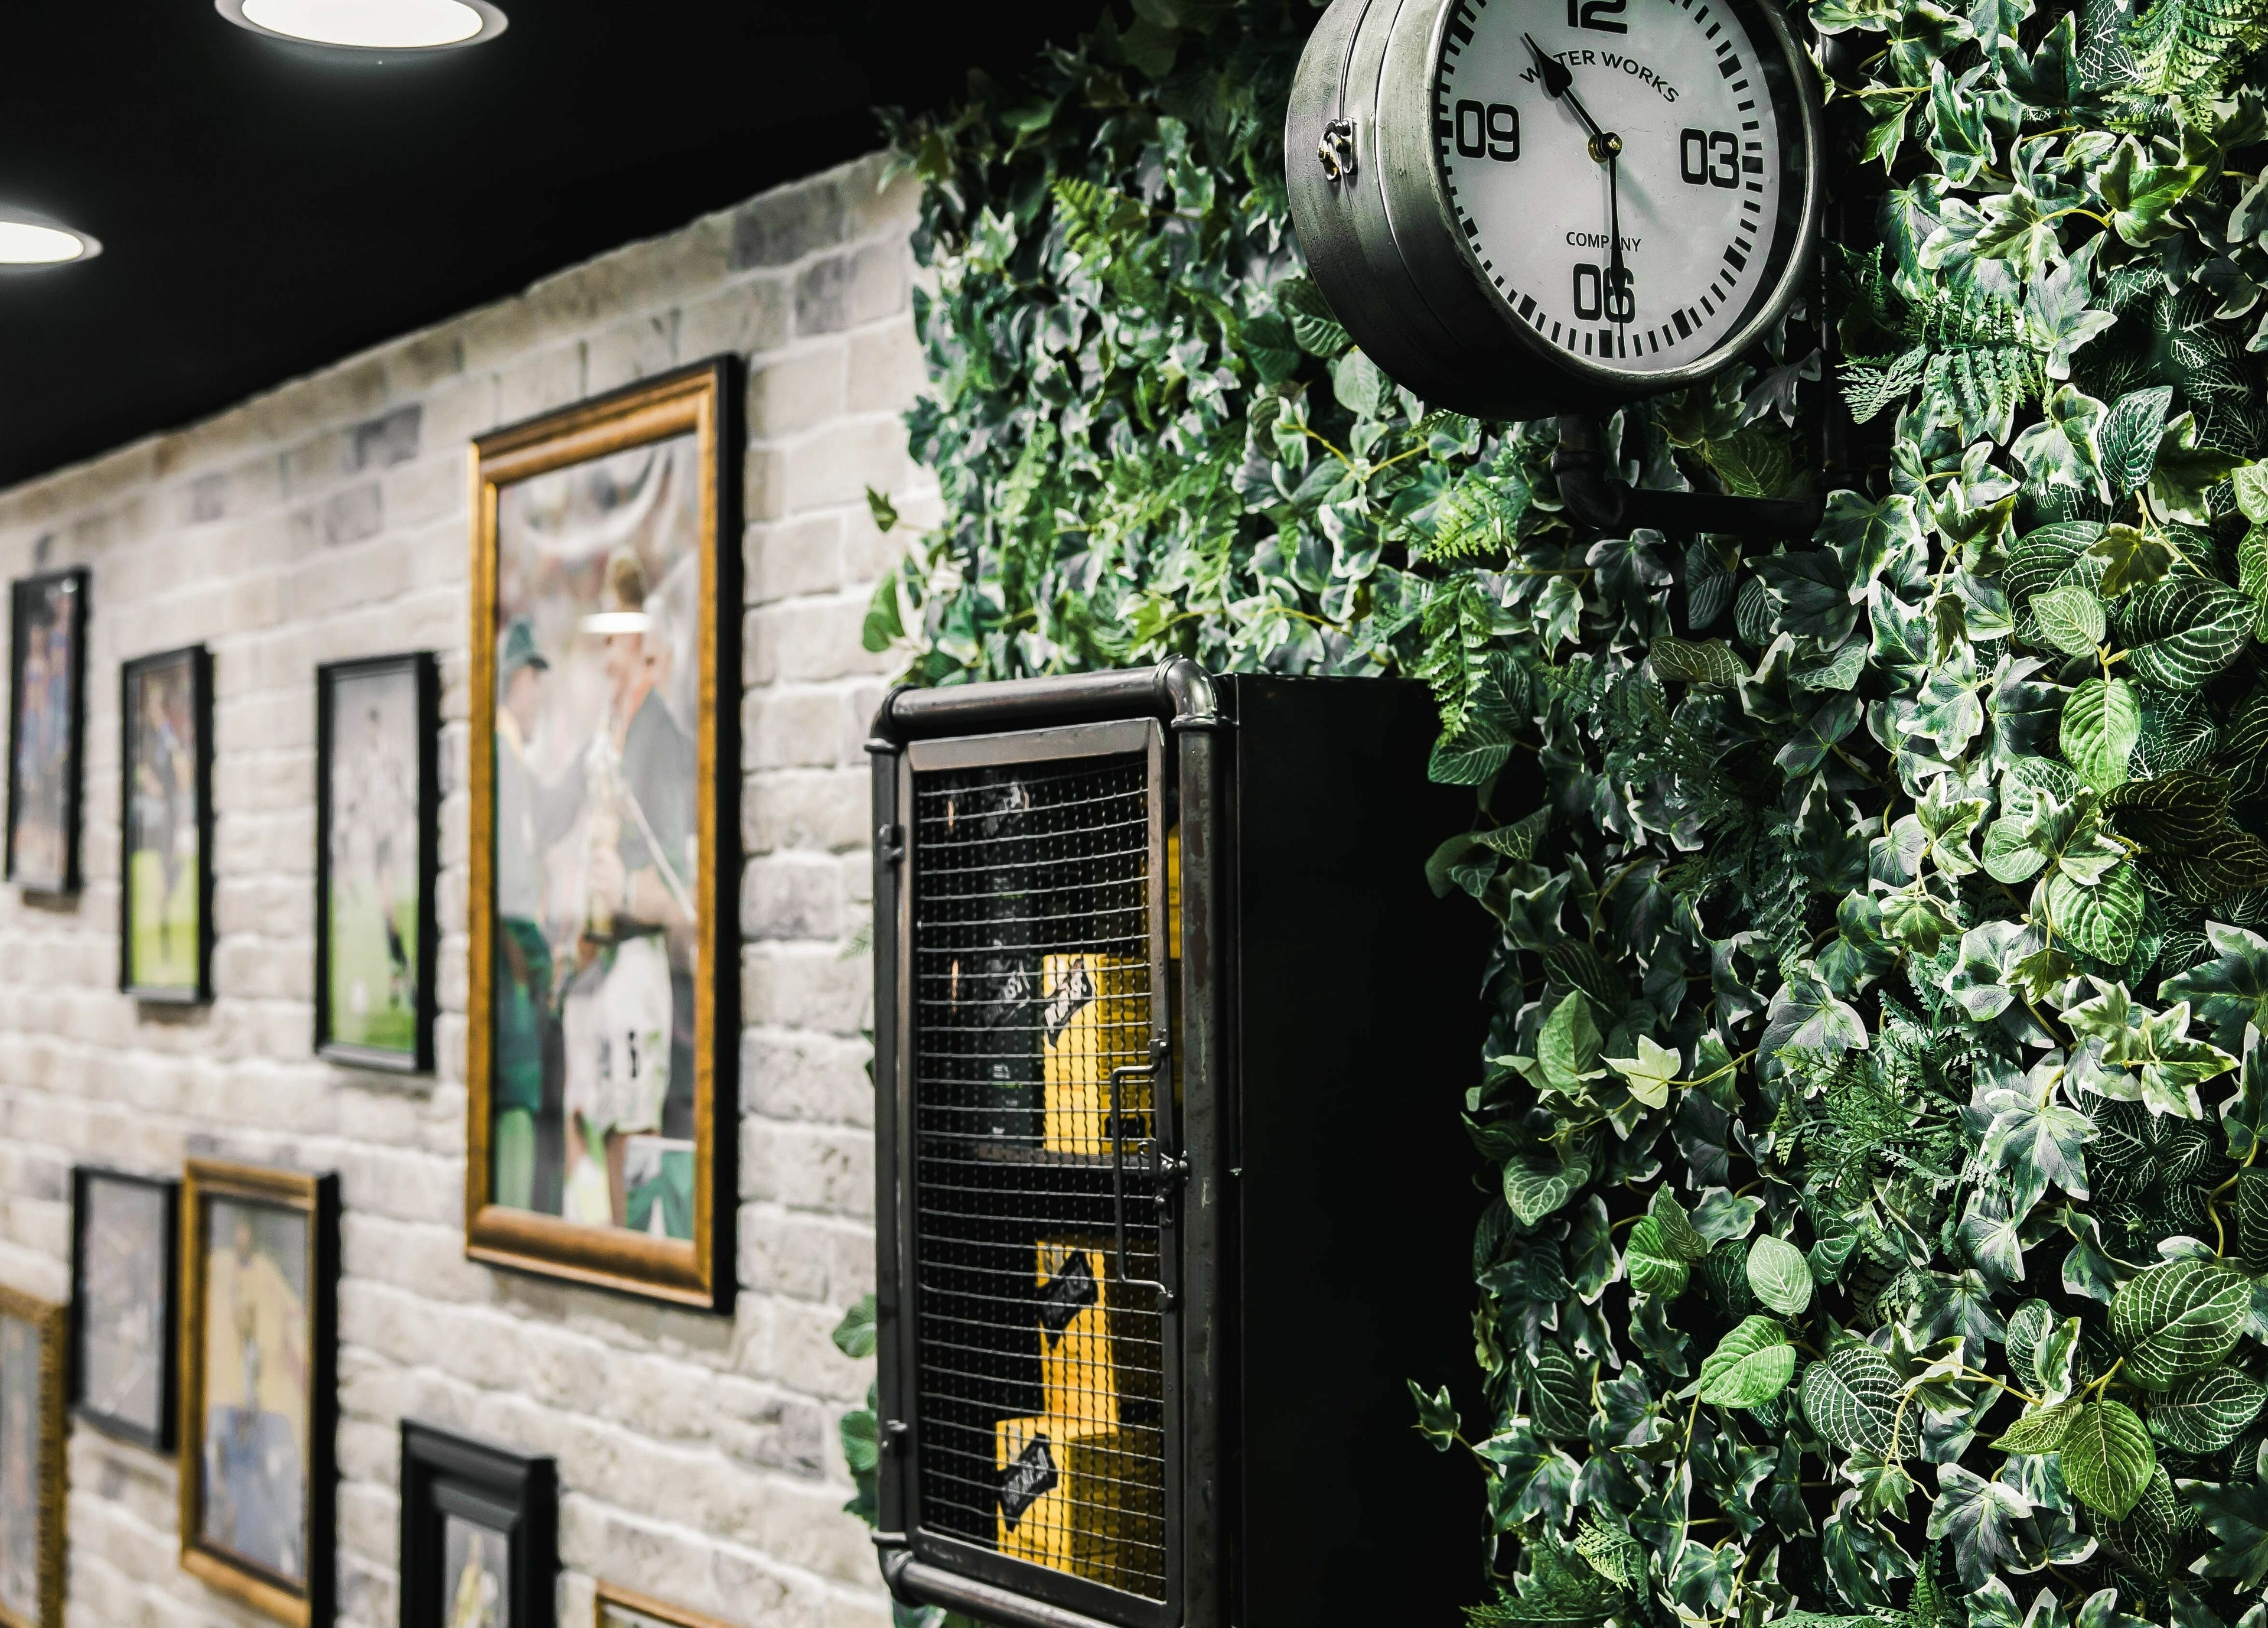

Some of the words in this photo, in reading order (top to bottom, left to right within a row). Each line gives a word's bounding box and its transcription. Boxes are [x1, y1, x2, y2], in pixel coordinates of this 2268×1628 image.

[1518, 50, 1596, 84] WTER
[1601, 51, 1679, 103] WORKS
[1455, 99, 1520, 162] 09
[1679, 128, 1740, 190] 03
[1566, 232, 1641, 252] COMPNY
[1573, 263, 1635, 324] 06
